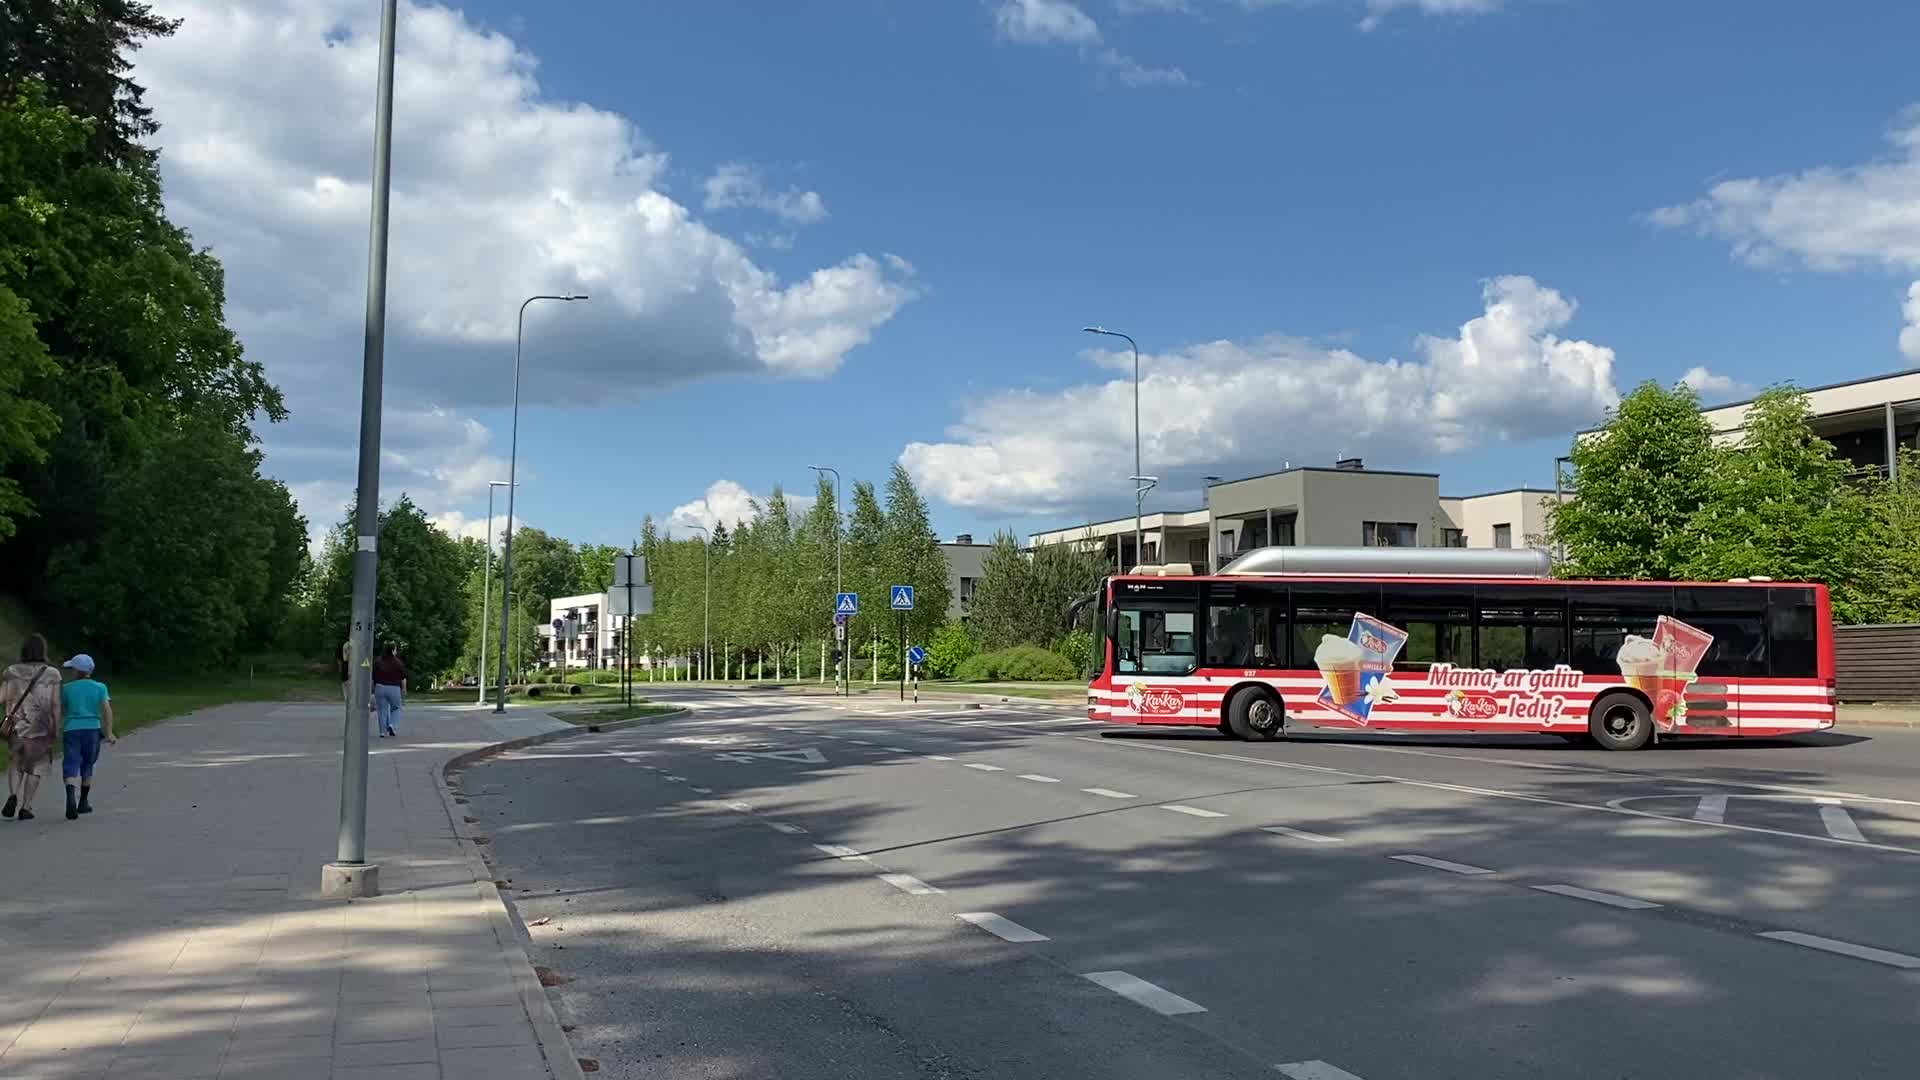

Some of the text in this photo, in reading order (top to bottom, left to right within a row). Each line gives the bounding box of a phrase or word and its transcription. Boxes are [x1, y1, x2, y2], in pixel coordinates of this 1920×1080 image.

[1429, 666, 1581, 692] Mama, ar galiu
[1143, 690, 1183, 710] KarKar
[1461, 697, 1497, 715] KarKar
[1508, 696, 1564, 723] ledų?
